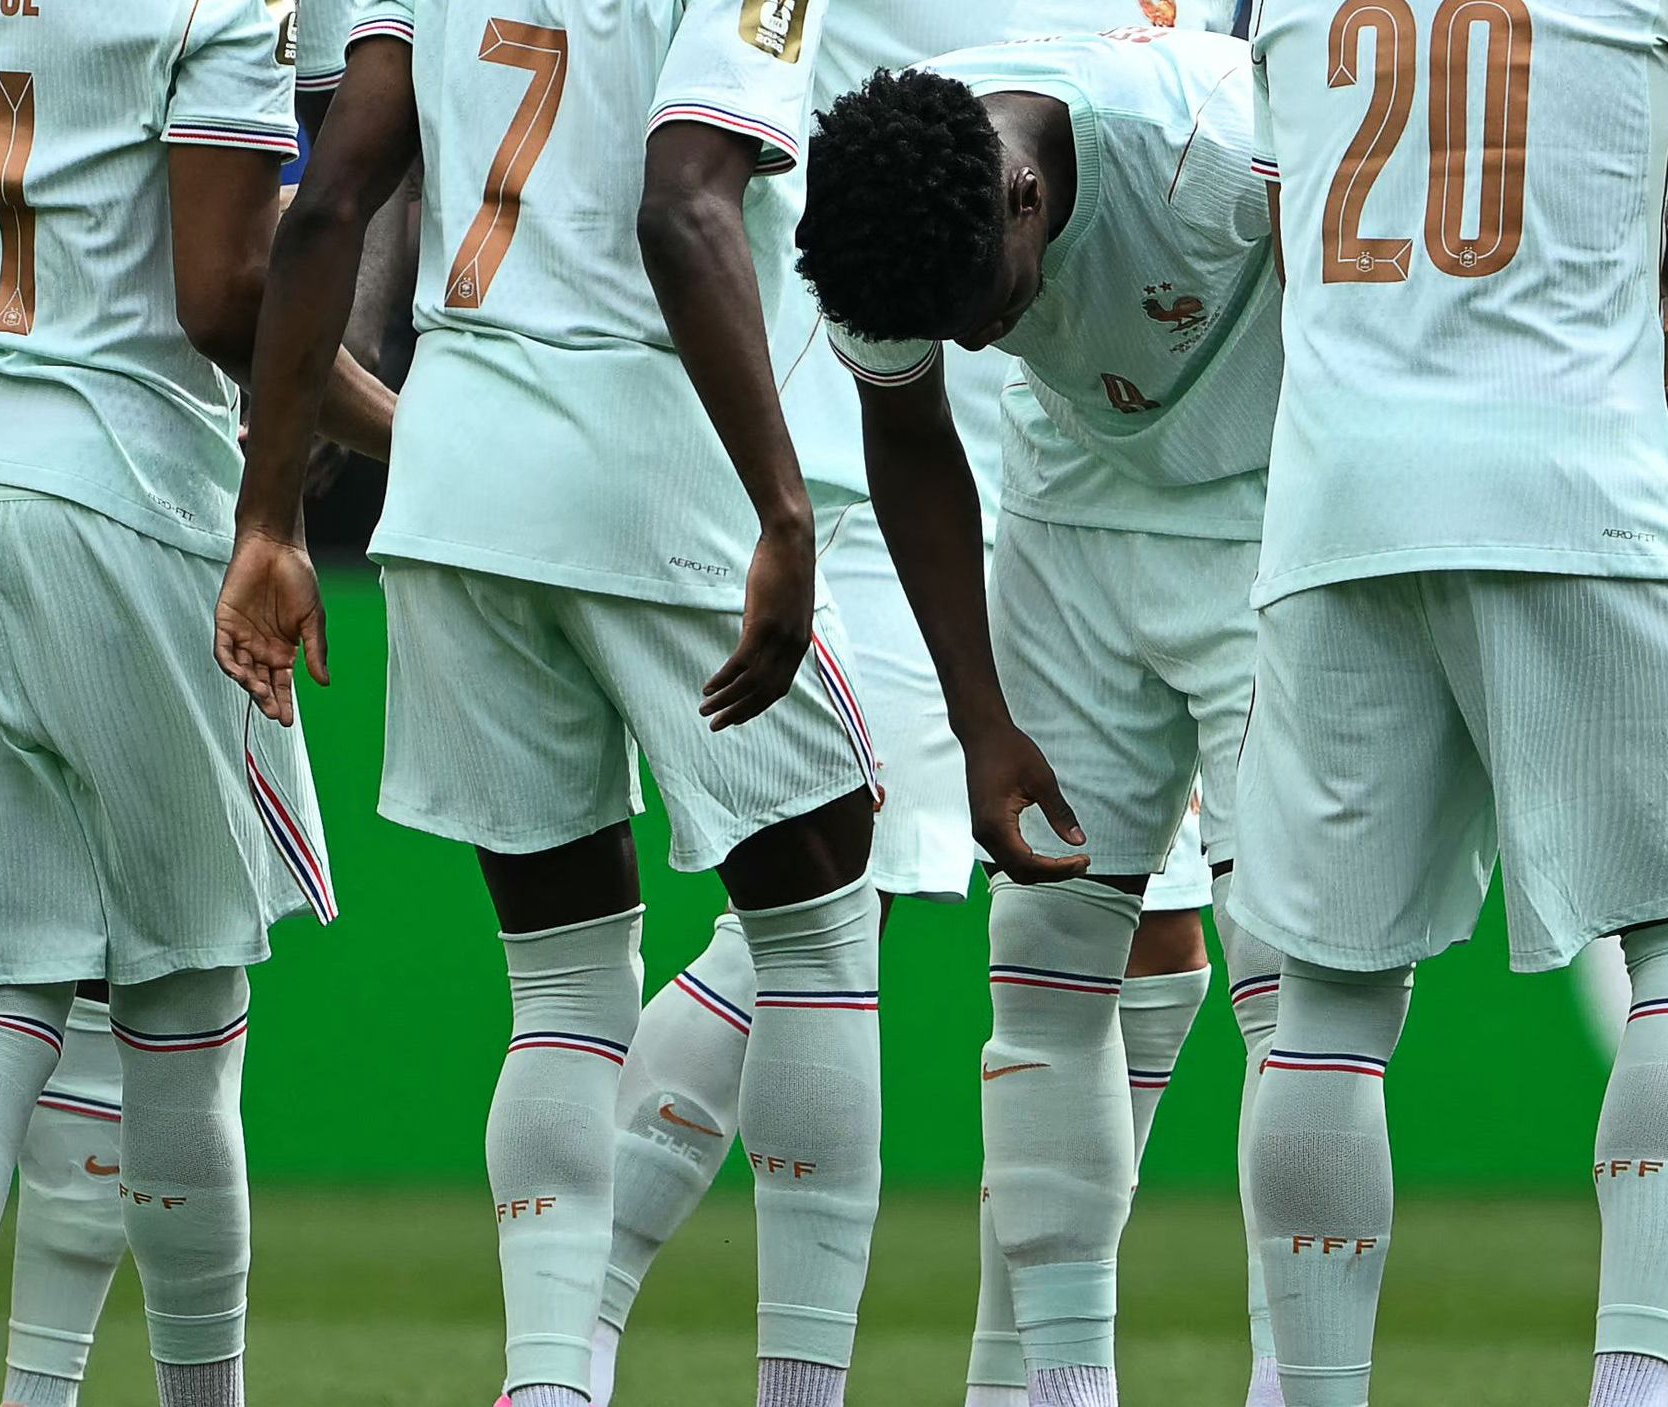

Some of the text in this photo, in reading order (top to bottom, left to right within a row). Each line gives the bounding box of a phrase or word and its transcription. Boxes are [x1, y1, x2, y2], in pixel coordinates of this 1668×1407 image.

[444, 17, 569, 309] 7
[1601, 528, 1656, 542] AERO-FIT
[669, 557, 729, 577] AERO-FIT
[749, 1152, 817, 1180] FFF
[1595, 1160, 1664, 1184] FFF
[119, 1182, 187, 1210] FFF
[497, 1196, 557, 1224] FFF
[1293, 1235, 1377, 1255] FFF
